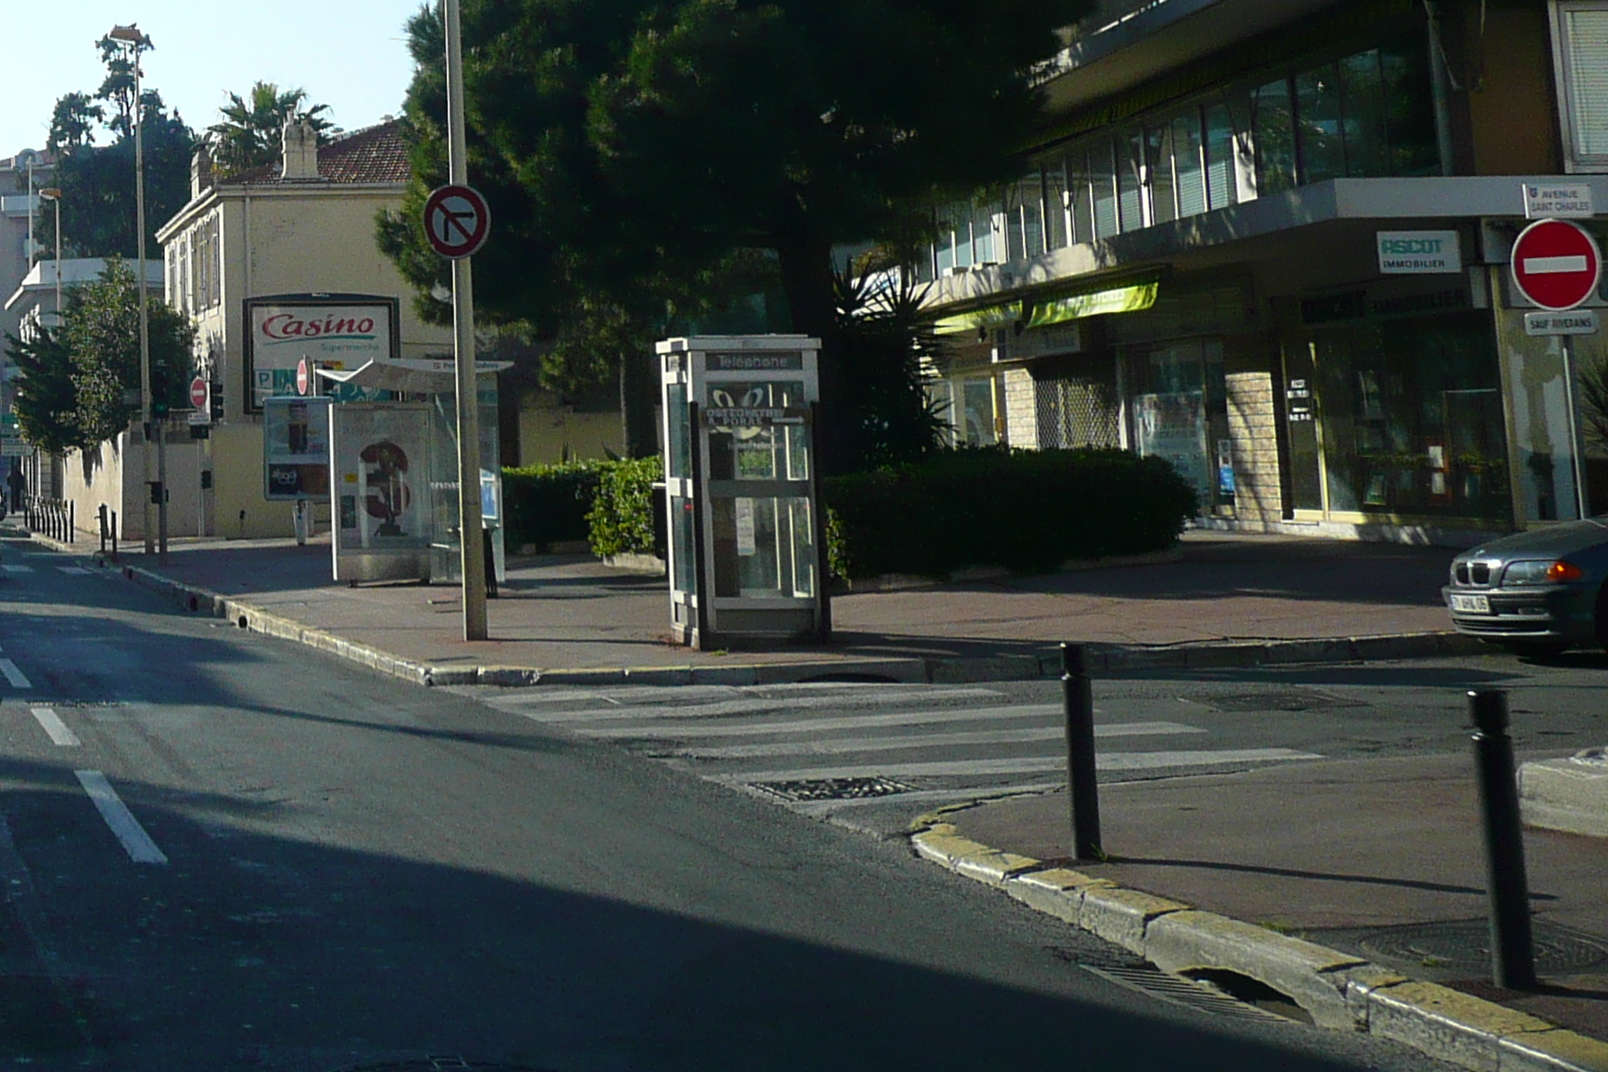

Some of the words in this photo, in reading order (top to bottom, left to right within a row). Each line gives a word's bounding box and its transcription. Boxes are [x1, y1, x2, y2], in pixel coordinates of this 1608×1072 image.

[1541, 190, 1579, 199] AVENUE
[1530, 202, 1553, 212] SAINT
[1554, 201, 1590, 212] CHARLES
[1380, 238, 1444, 254] ASCOT
[1382, 259, 1446, 269] IMMOBILIER
[261, 313, 375, 340] Casino
[1530, 319, 1550, 330] SAUF
[1552, 317, 1592, 329] RIVERAINS
